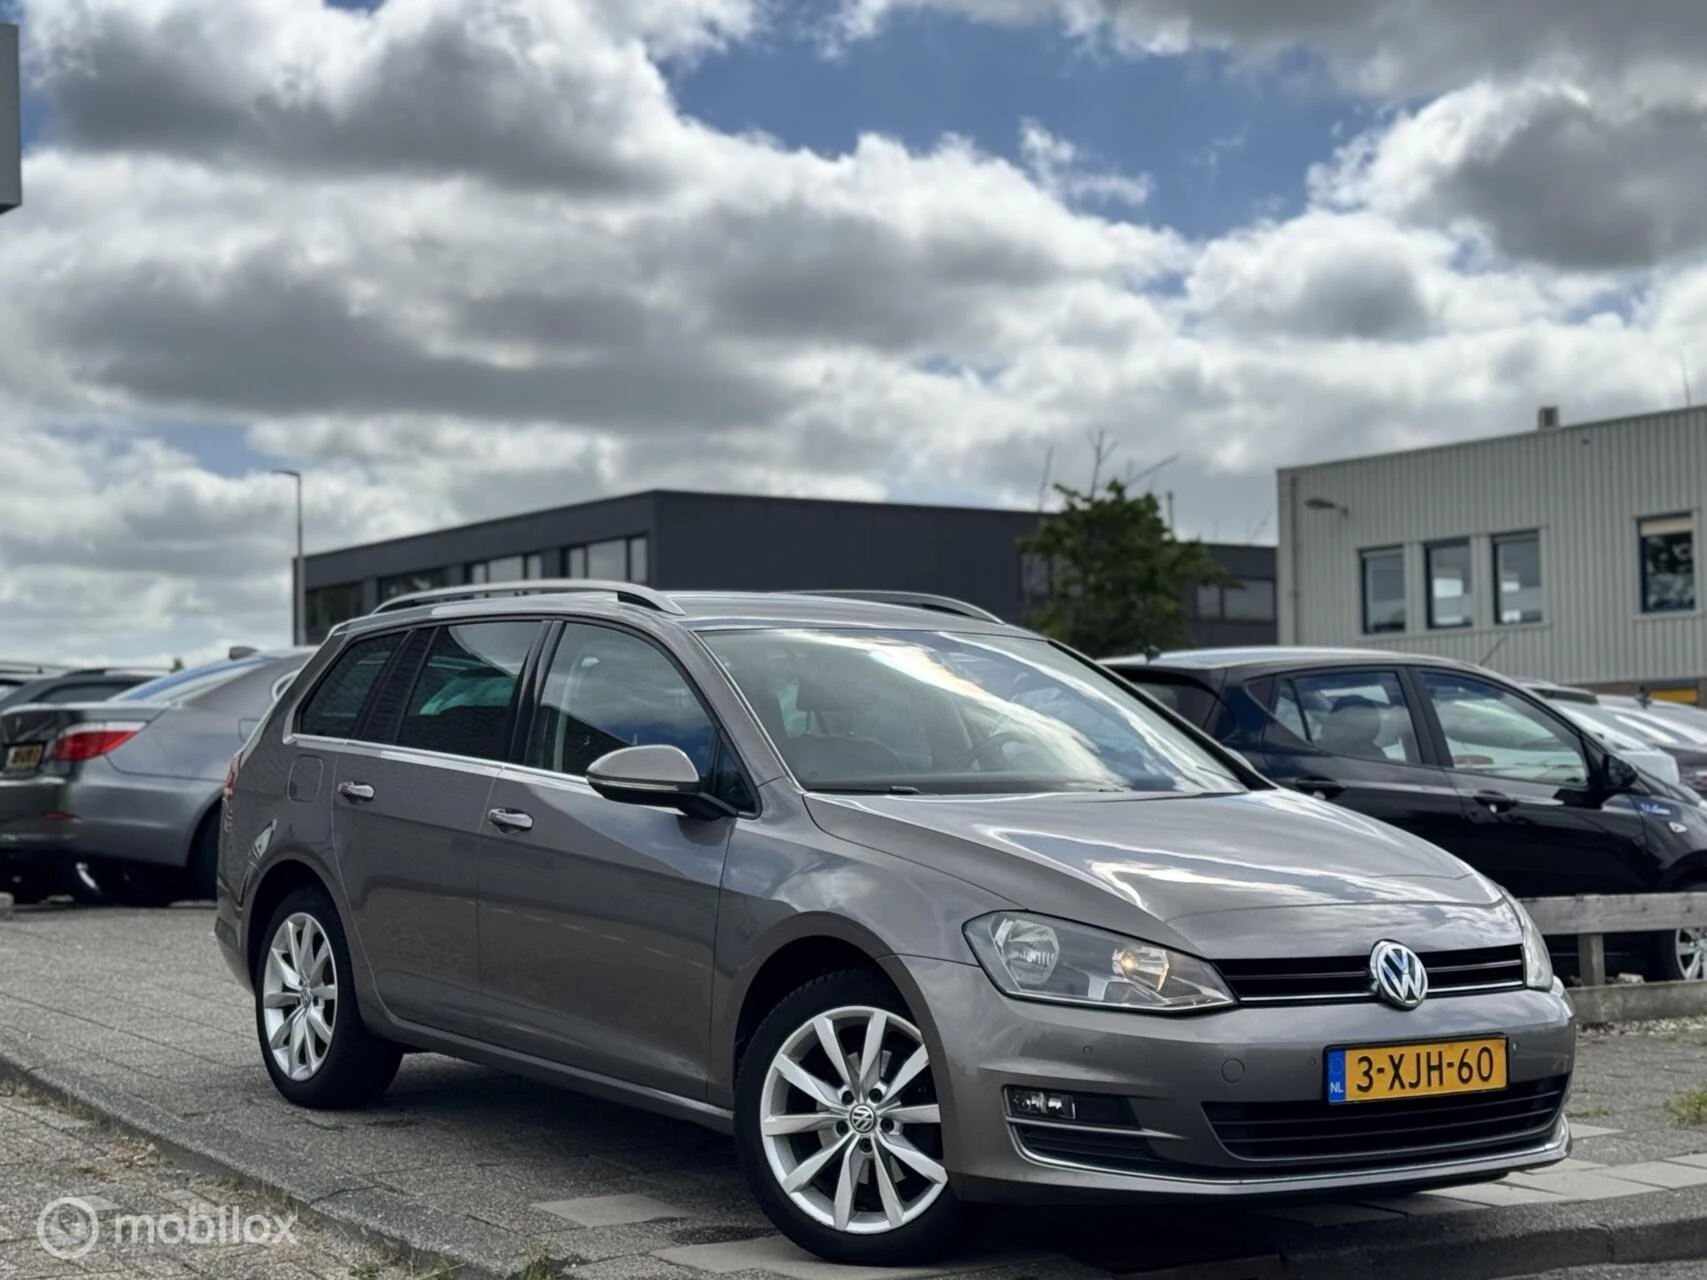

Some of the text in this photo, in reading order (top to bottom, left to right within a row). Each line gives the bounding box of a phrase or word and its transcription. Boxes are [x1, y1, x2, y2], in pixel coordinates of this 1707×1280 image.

[1375, 941, 1428, 1005] VW
[1330, 1081, 1344, 1094] NL
[1356, 1046, 1494, 1093] 3-XJH-60
